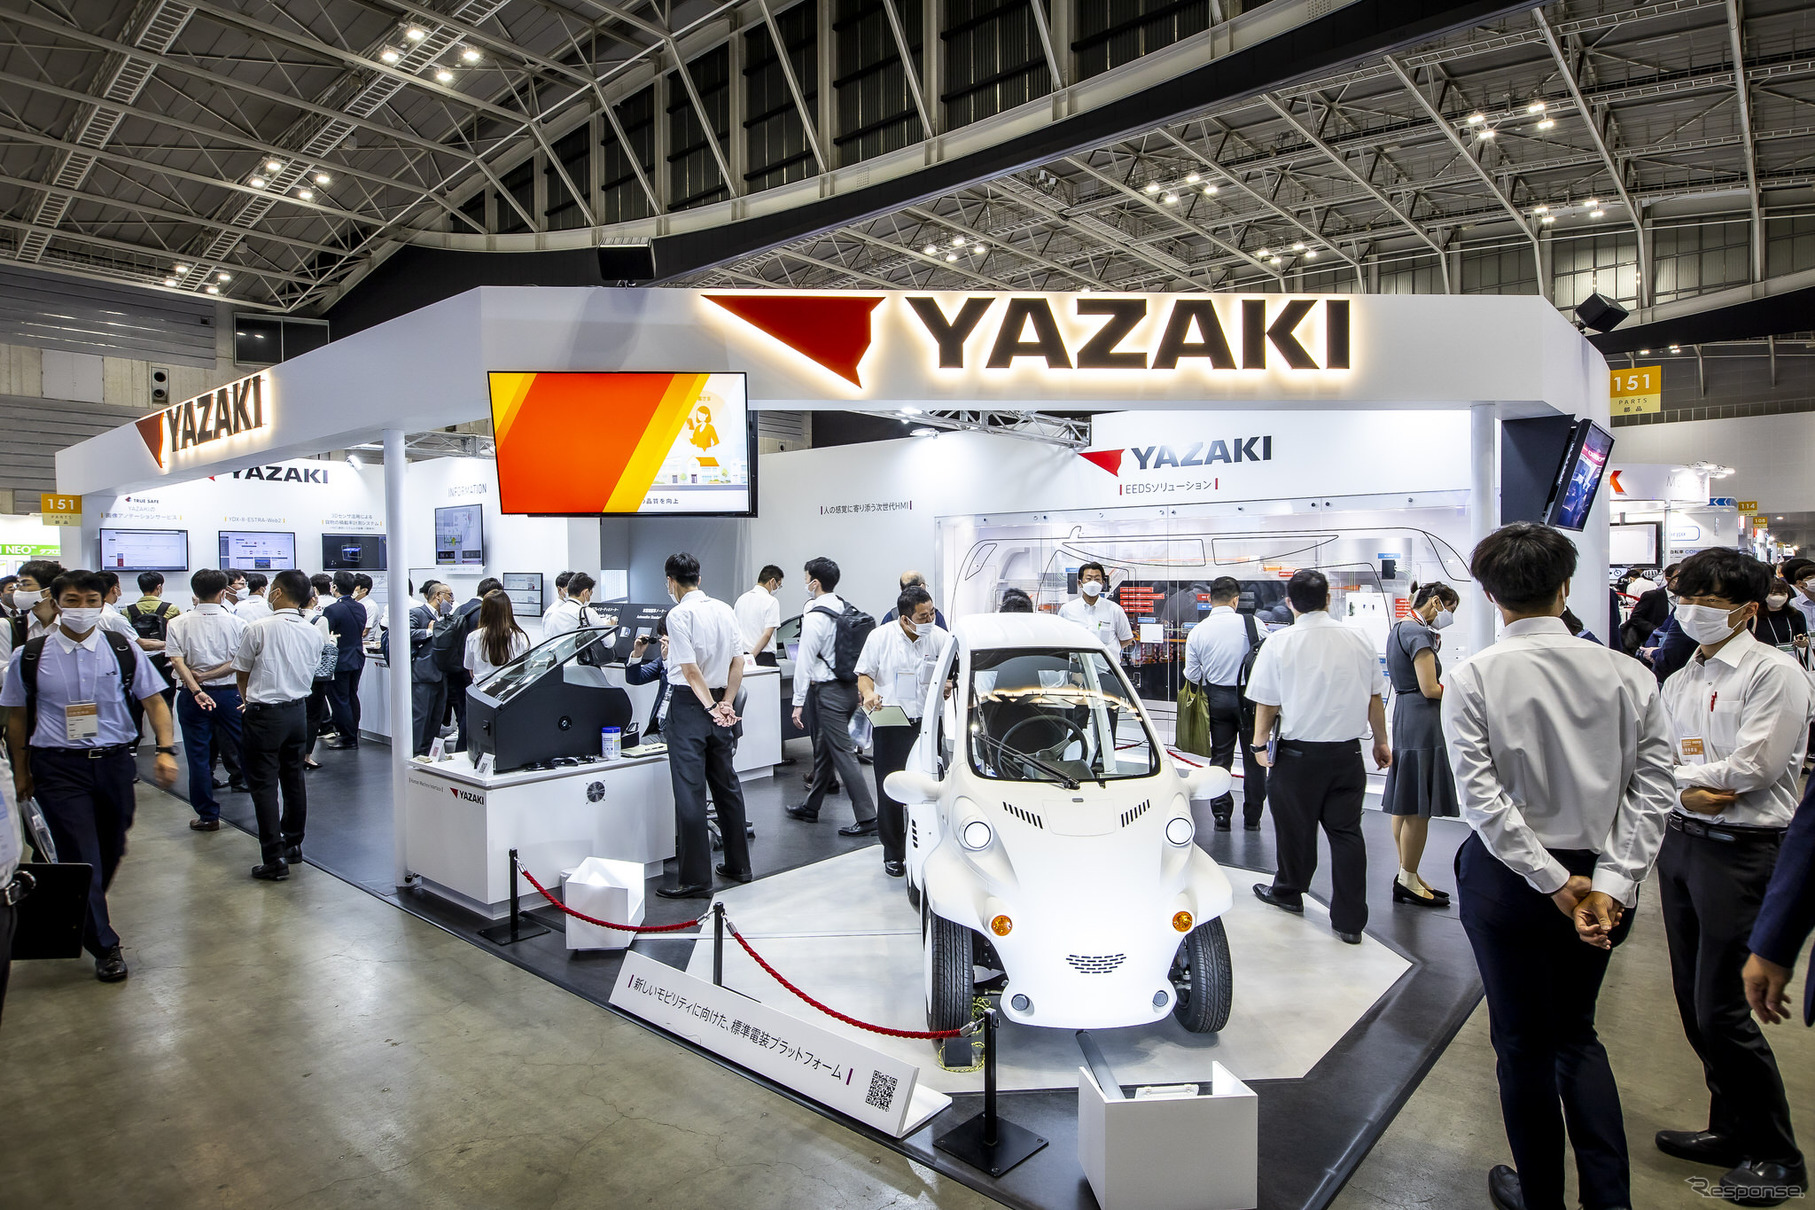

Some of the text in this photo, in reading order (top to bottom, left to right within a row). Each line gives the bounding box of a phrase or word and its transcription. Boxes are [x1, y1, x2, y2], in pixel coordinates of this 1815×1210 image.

[905, 297, 1350, 370] YAZAKI
[1614, 374, 1650, 391] 151
[166, 375, 263, 453] YAZAKI
[1131, 435, 1272, 470] YAZAKI
[448, 483, 487, 498] INFORMATION
[1125, 480, 1212, 495] EEDSソリューション
[47, 498, 75, 511] 151
[823, 502, 909, 515] 人の感覚に寄り添う次世代HMI
[459, 790, 485, 805] YAZAKI
[633, 977, 843, 1081] 新しいモビリティに向けた、標準電装プラットフォーム
